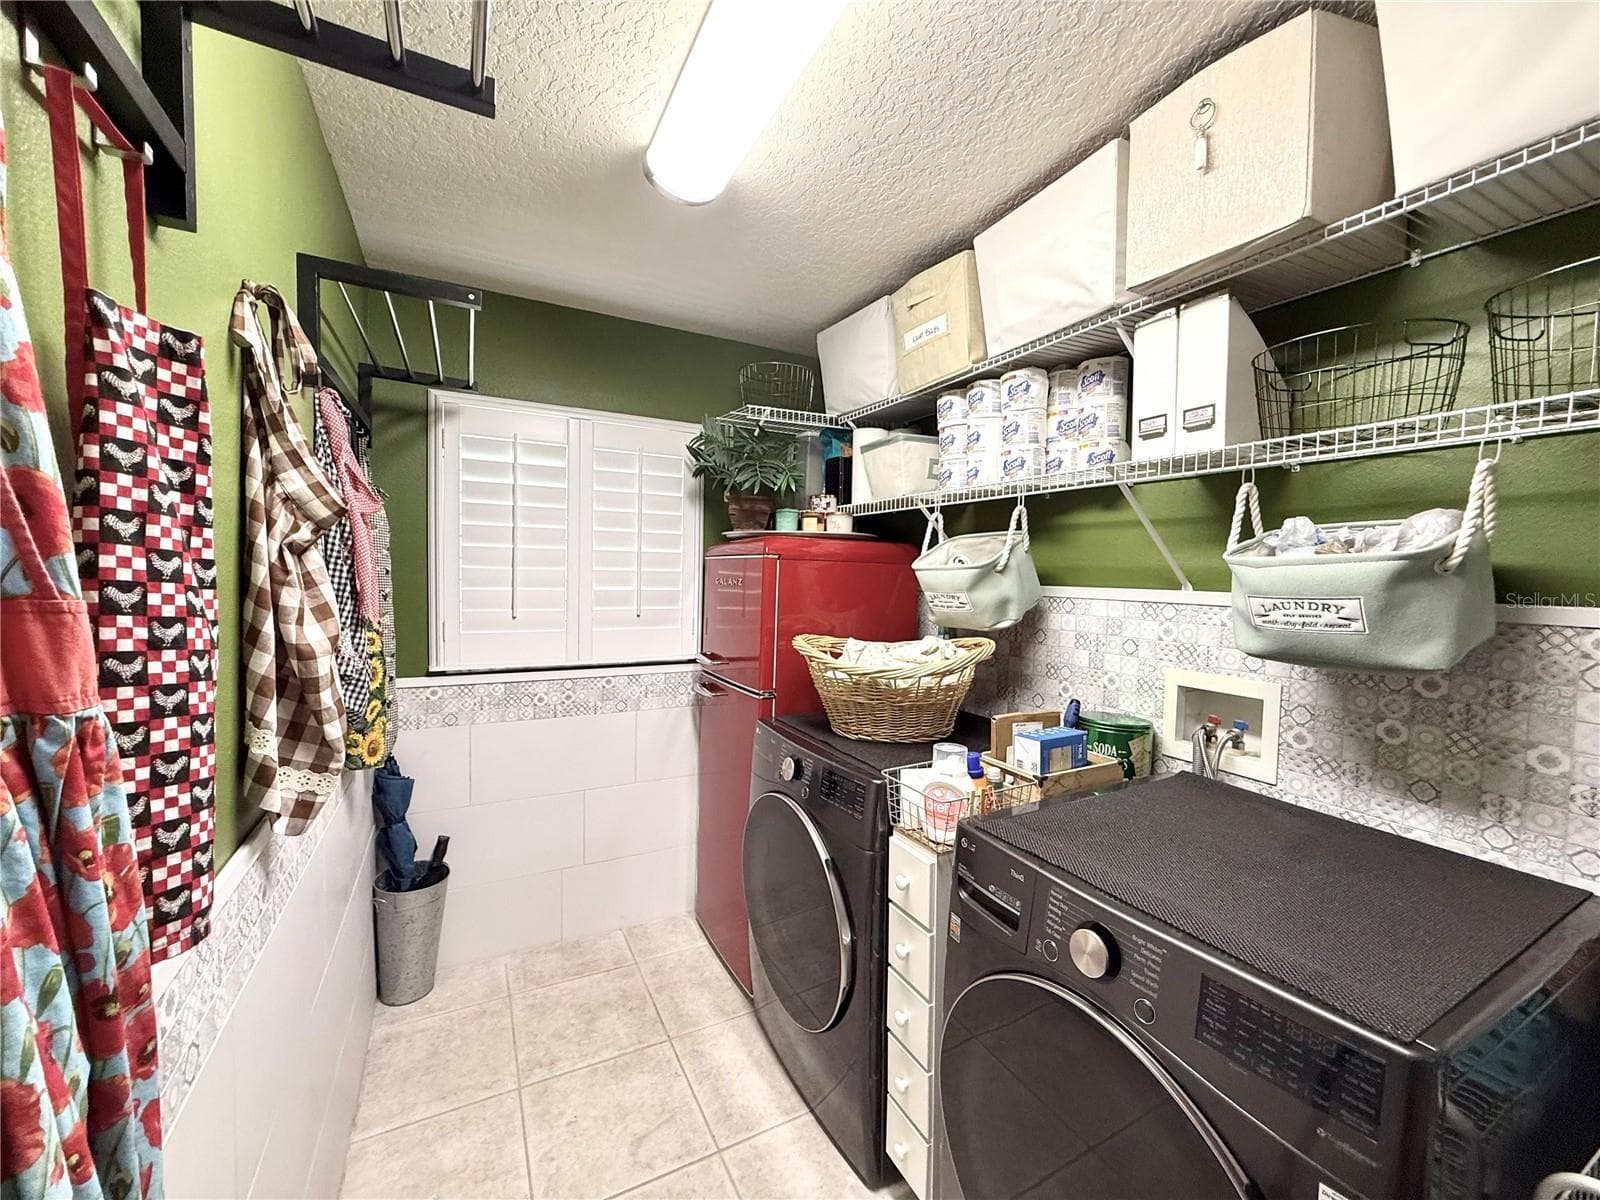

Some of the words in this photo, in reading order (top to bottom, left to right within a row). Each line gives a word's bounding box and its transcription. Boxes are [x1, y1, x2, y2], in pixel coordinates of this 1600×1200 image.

[1080, 370, 1105, 388] Scott
[1008, 380, 1031, 398] Scott
[1004, 456, 1026, 474] Scott
[1089, 450, 1115, 466] Scott
[715, 577, 744, 586] GALANZ
[1260, 600, 1346, 615] LAUNDRY
[1092, 741, 1118, 758] SODA
